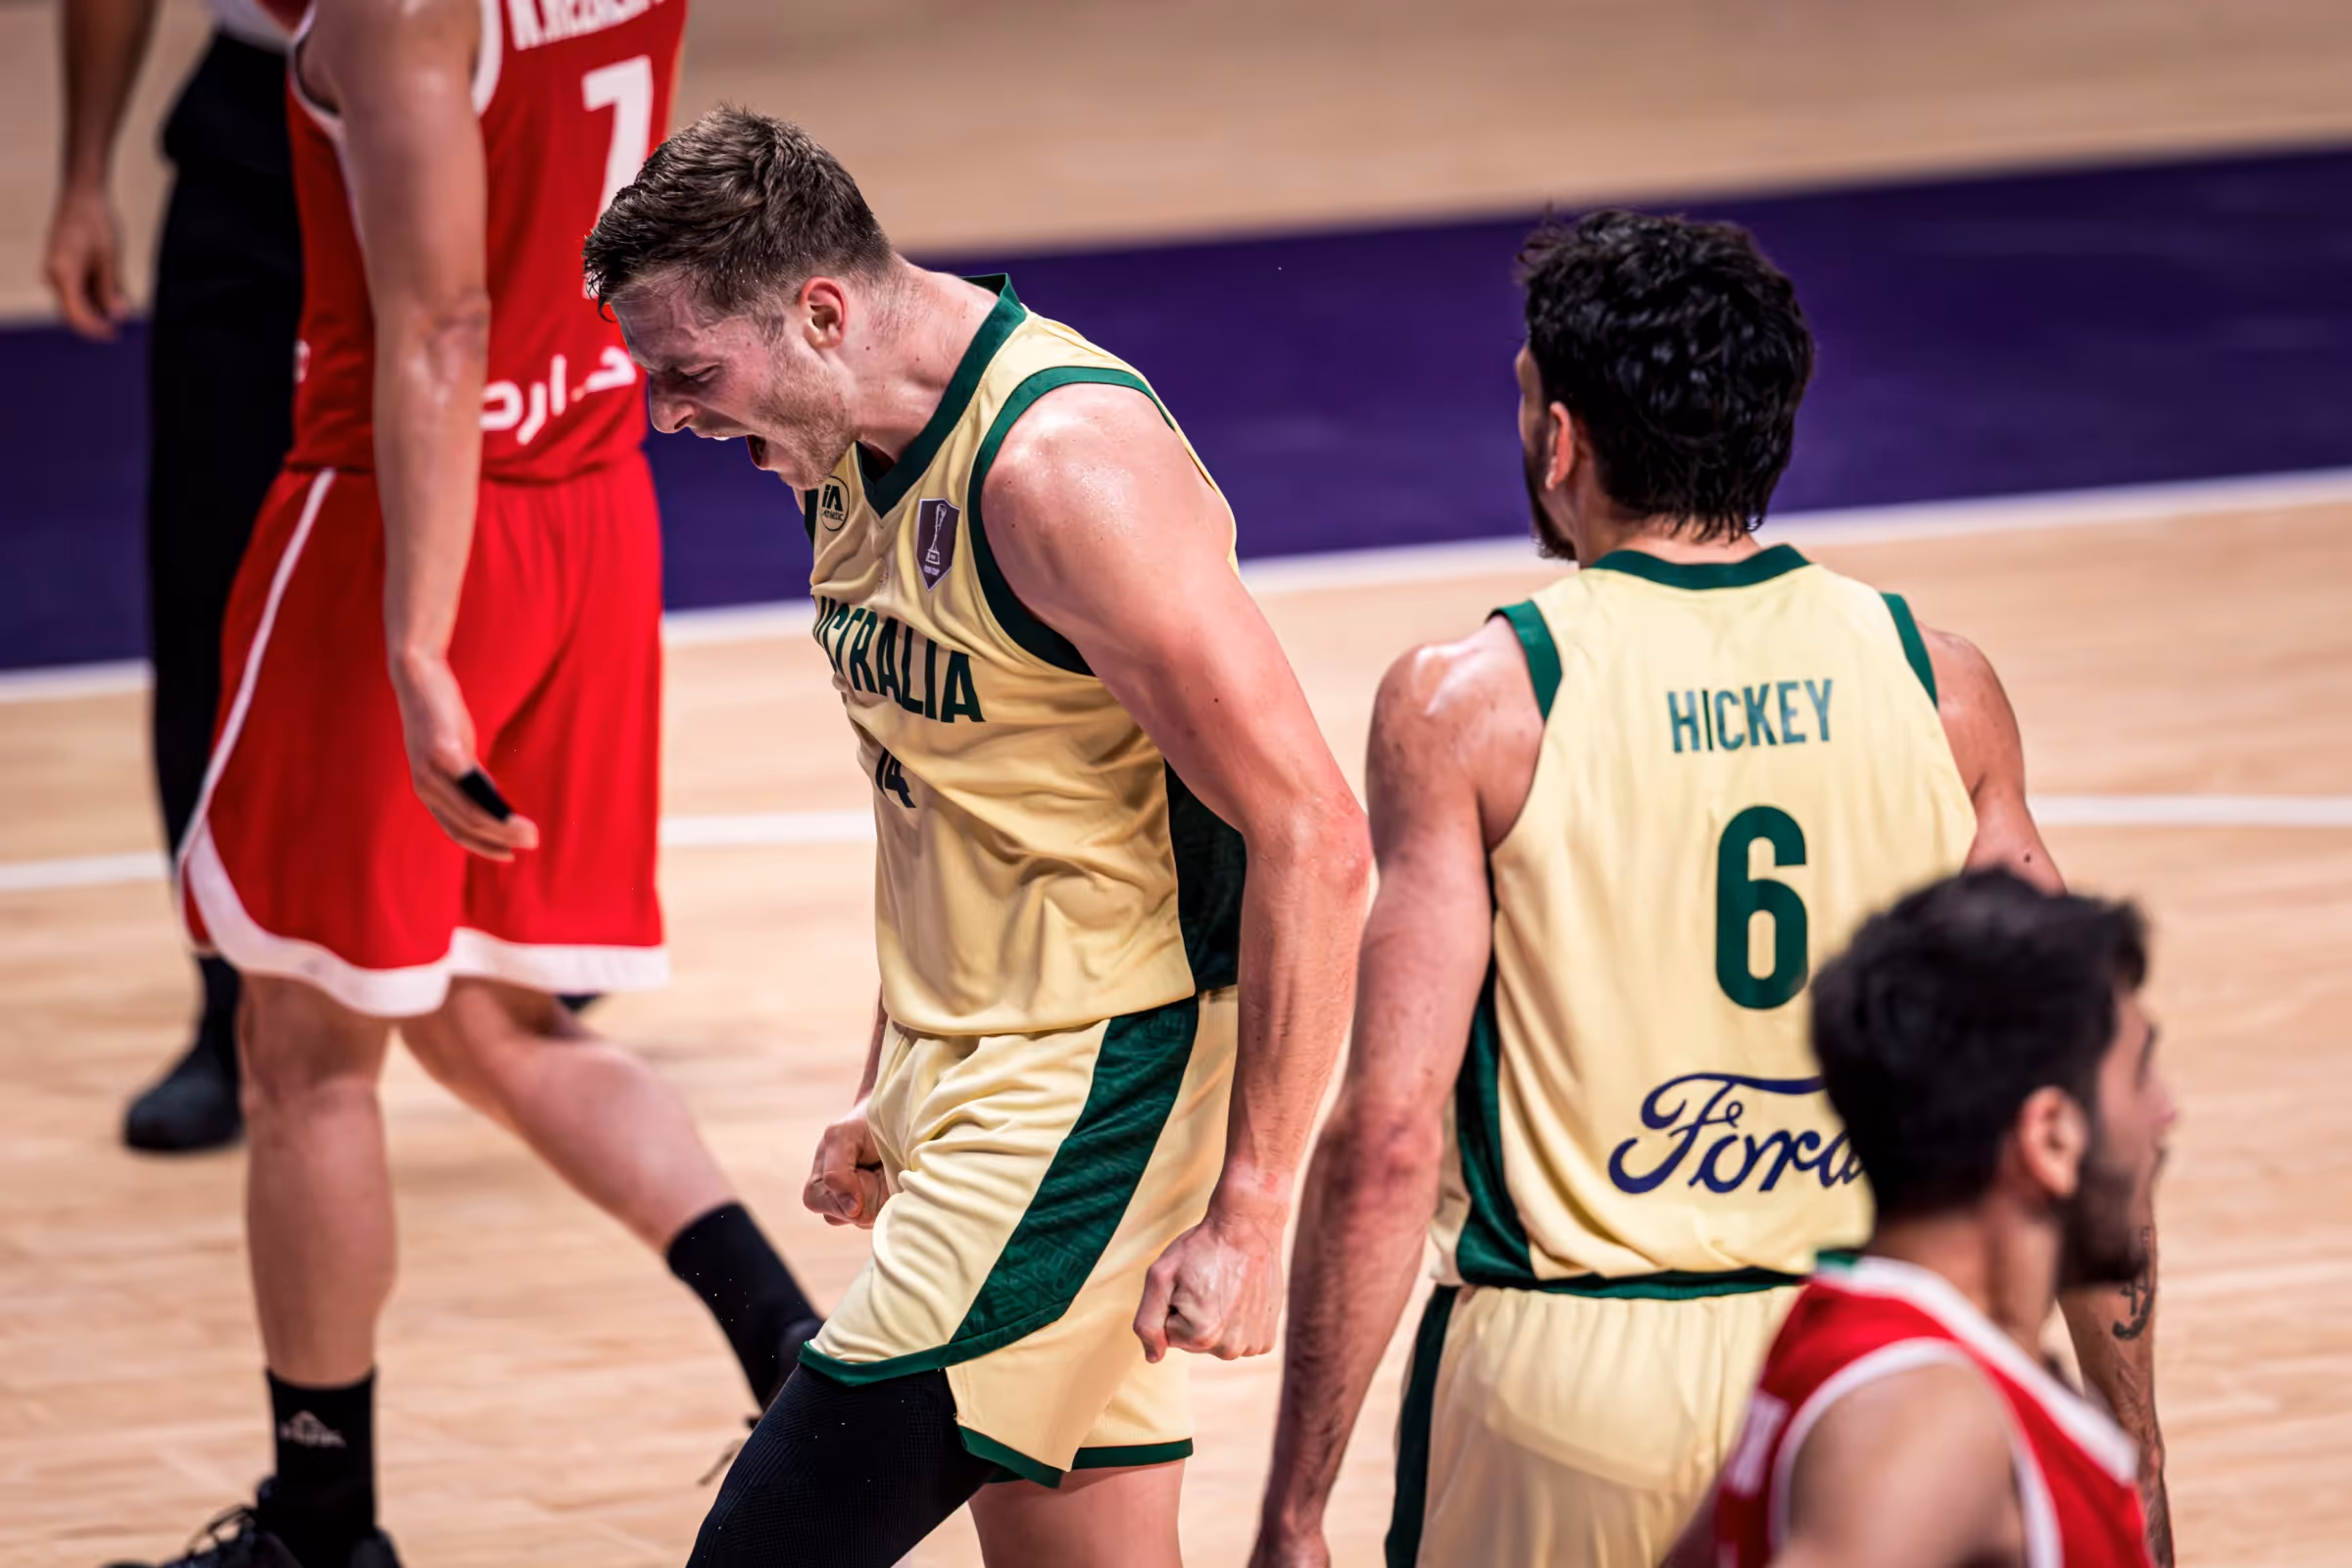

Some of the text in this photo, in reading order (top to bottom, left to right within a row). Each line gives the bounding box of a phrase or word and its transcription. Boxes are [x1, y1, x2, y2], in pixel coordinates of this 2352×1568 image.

[581, 54, 654, 299] 7
[875, 747, 917, 808] 14
[1666, 678, 1833, 754] HICKEY
[1715, 806, 1809, 1010] 6
